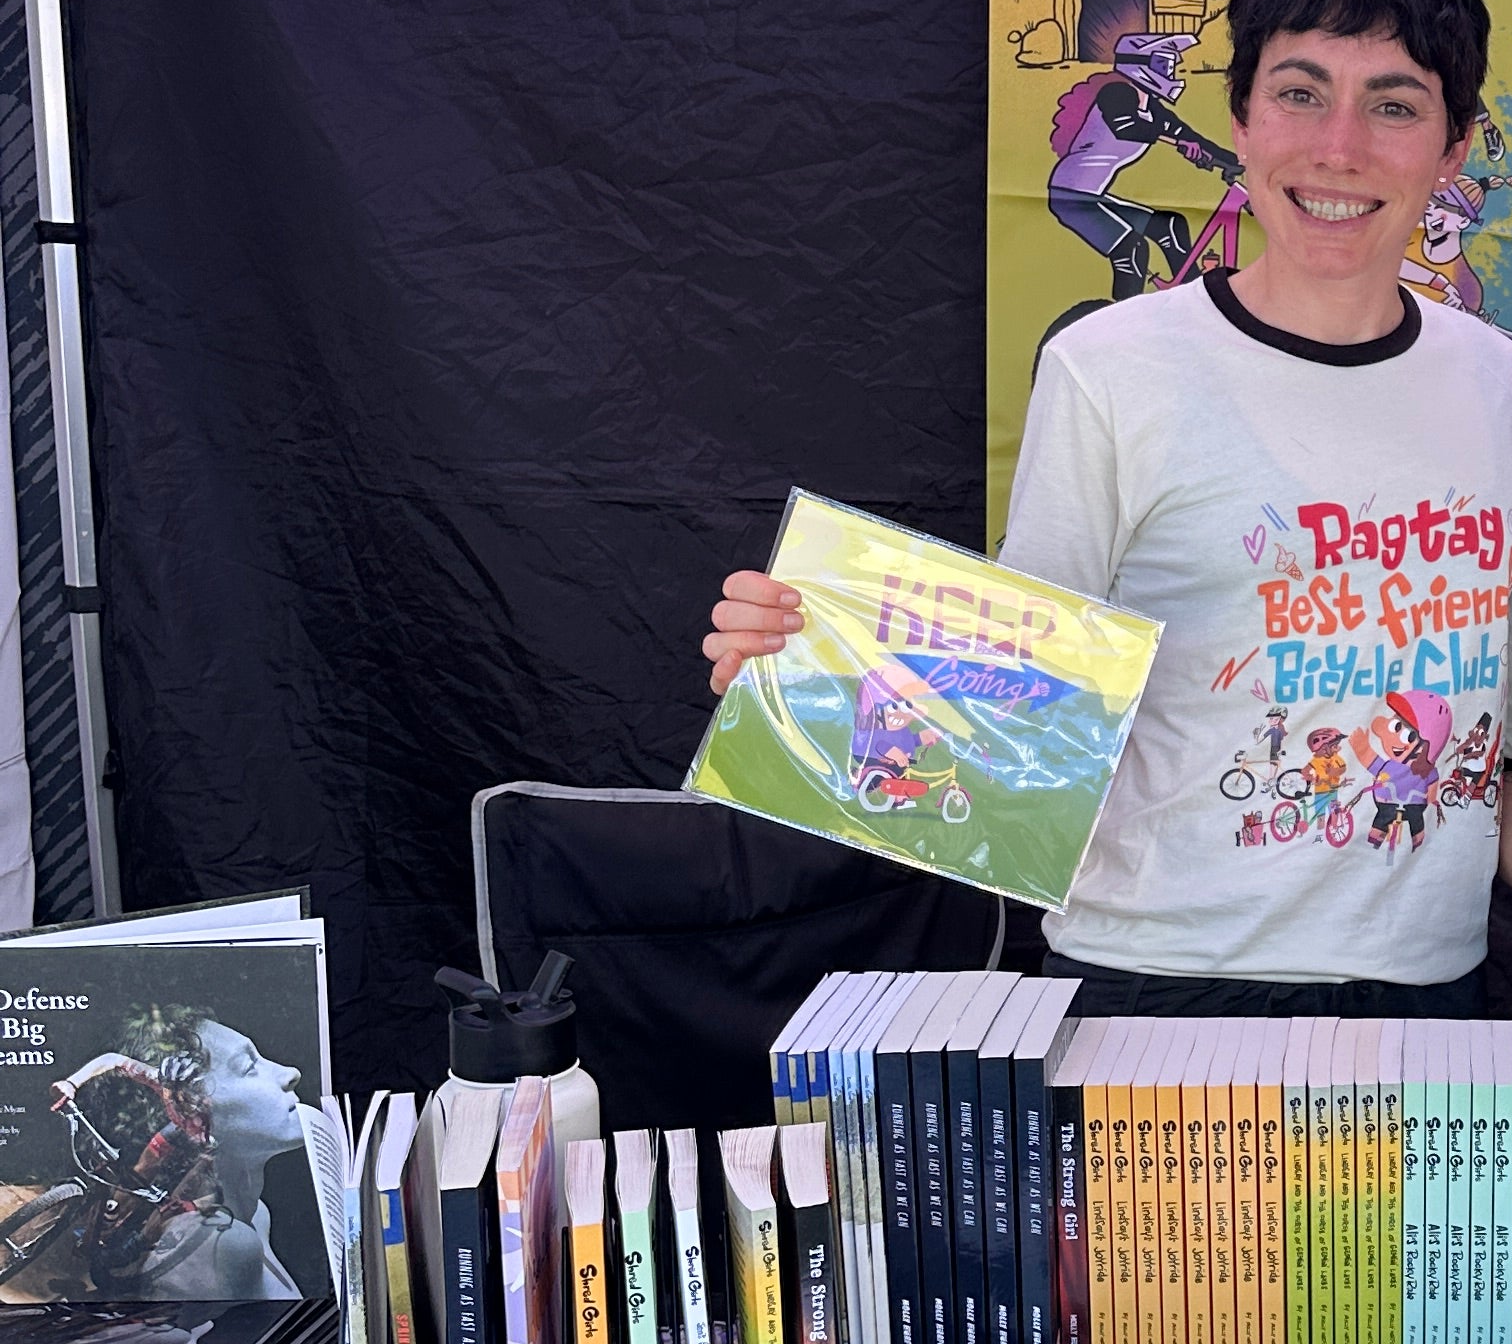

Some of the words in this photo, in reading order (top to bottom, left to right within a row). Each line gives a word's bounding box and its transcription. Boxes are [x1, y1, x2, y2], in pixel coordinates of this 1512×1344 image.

[1298, 499, 1504, 571] Ragtag
[875, 574, 1059, 659] KEEP
[1258, 572, 1366, 638] Best
[1267, 640, 1403, 704] Bicycle
[1412, 631, 1500, 696] Club
[924, 656, 1035, 721] Going
[1, 1018, 46, 1046] Big
[1061, 1123, 1073, 1151] The
[1089, 1119, 1103, 1154] Shred
[1060, 1158, 1076, 1208] Strong
[1090, 1156, 1104, 1184] Girls
[759, 1220, 772, 1251] Shred
[1064, 1213, 1078, 1240] Girl
[625, 1251, 642, 1291] Shred
[685, 1245, 700, 1278] Shred
[763, 1253, 776, 1277] Girls
[808, 1244, 824, 1278] The
[461, 1292, 474, 1307] AS
[579, 1264, 597, 1304] Shred
[688, 1280, 702, 1306] Girls
[582, 1306, 599, 1338] Girls
[628, 1292, 646, 1324] Girls
[810, 1283, 827, 1343] Strong
